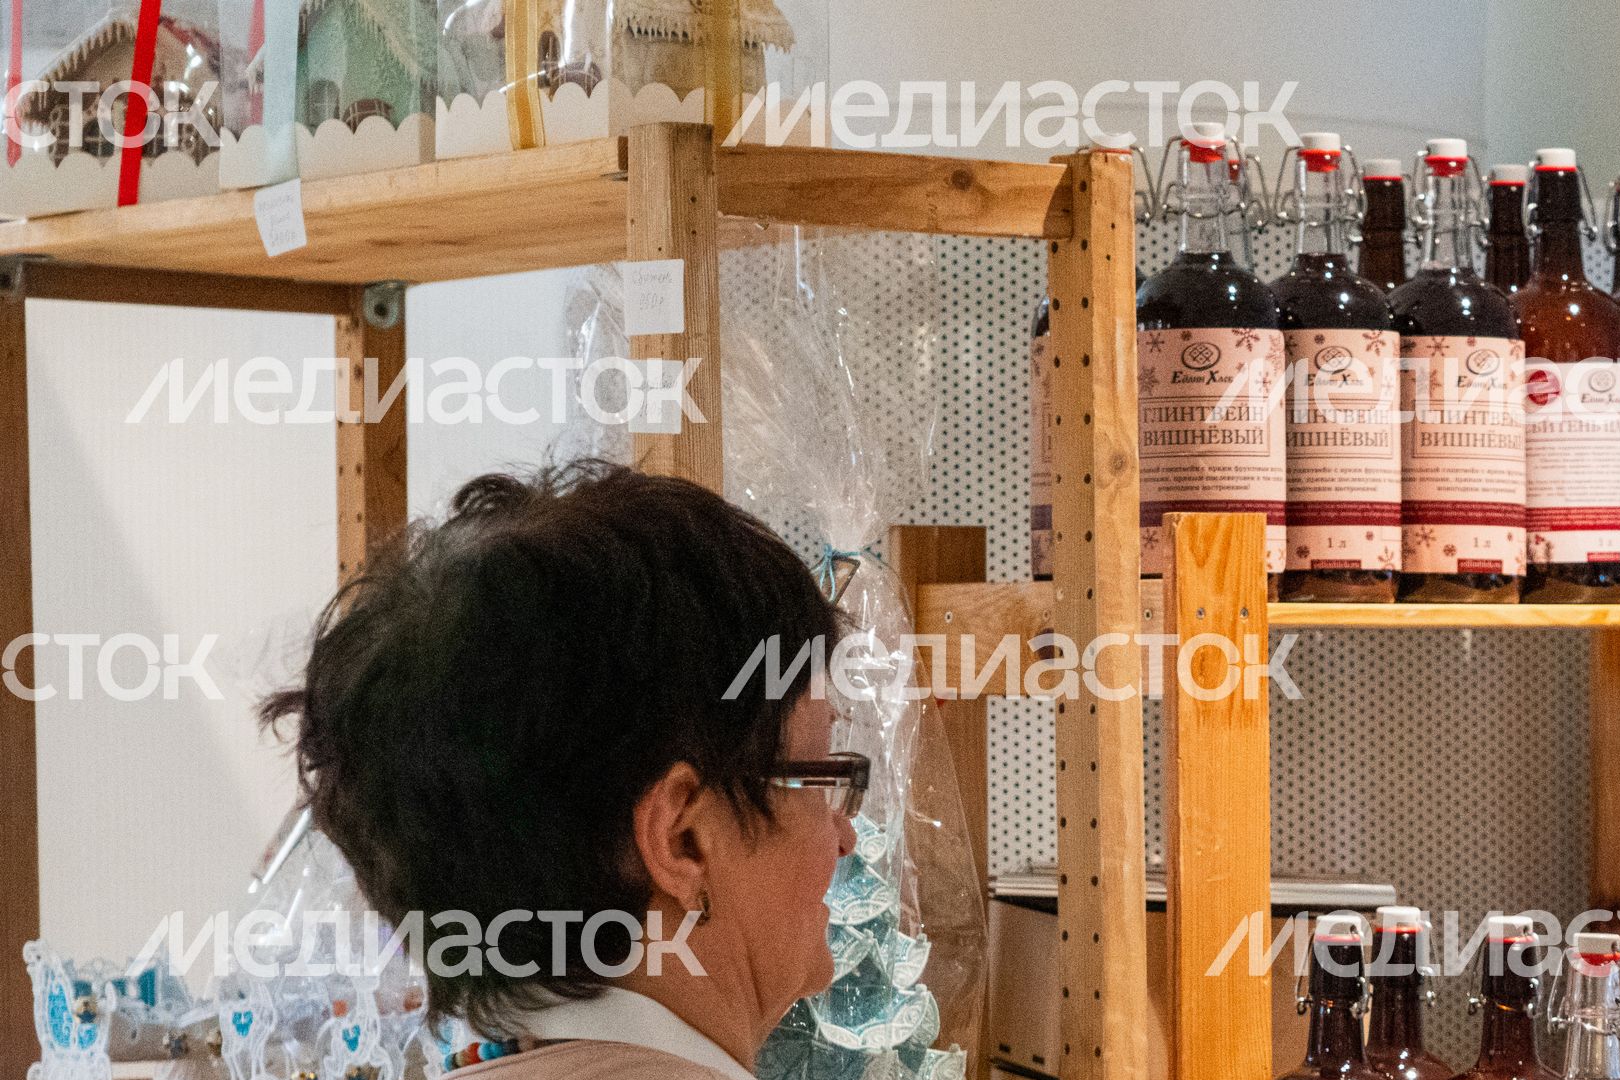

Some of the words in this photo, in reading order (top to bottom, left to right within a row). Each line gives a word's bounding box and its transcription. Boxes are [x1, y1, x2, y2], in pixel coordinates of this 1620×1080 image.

[1143, 403, 1264, 423] ГЛИНТВЕЙН
[1287, 407, 1389, 424] ЛИНТВЕЙН
[1143, 426, 1264, 447] ВИШНЁВЫЙ
[1286, 427, 1389, 448] ИШНЁВЫЙ
